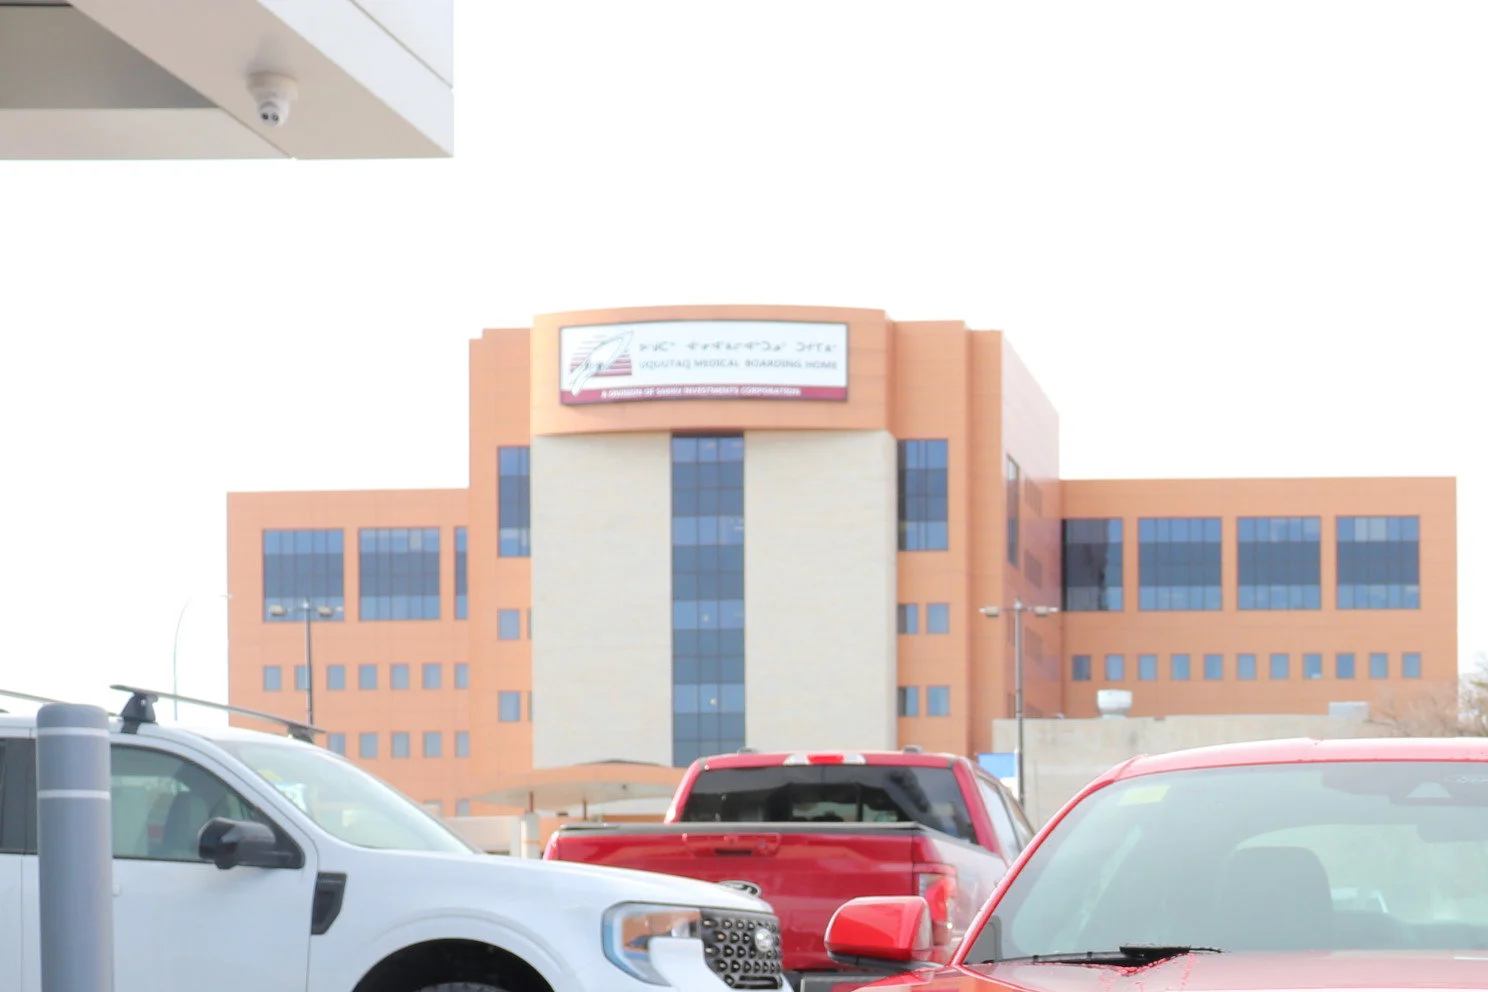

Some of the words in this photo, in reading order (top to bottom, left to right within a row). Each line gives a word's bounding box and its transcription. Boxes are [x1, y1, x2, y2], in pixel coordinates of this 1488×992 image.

[694, 359, 740, 368] MEDICAL
[745, 359, 802, 369] BOARDING
[805, 361, 838, 370] HOME
